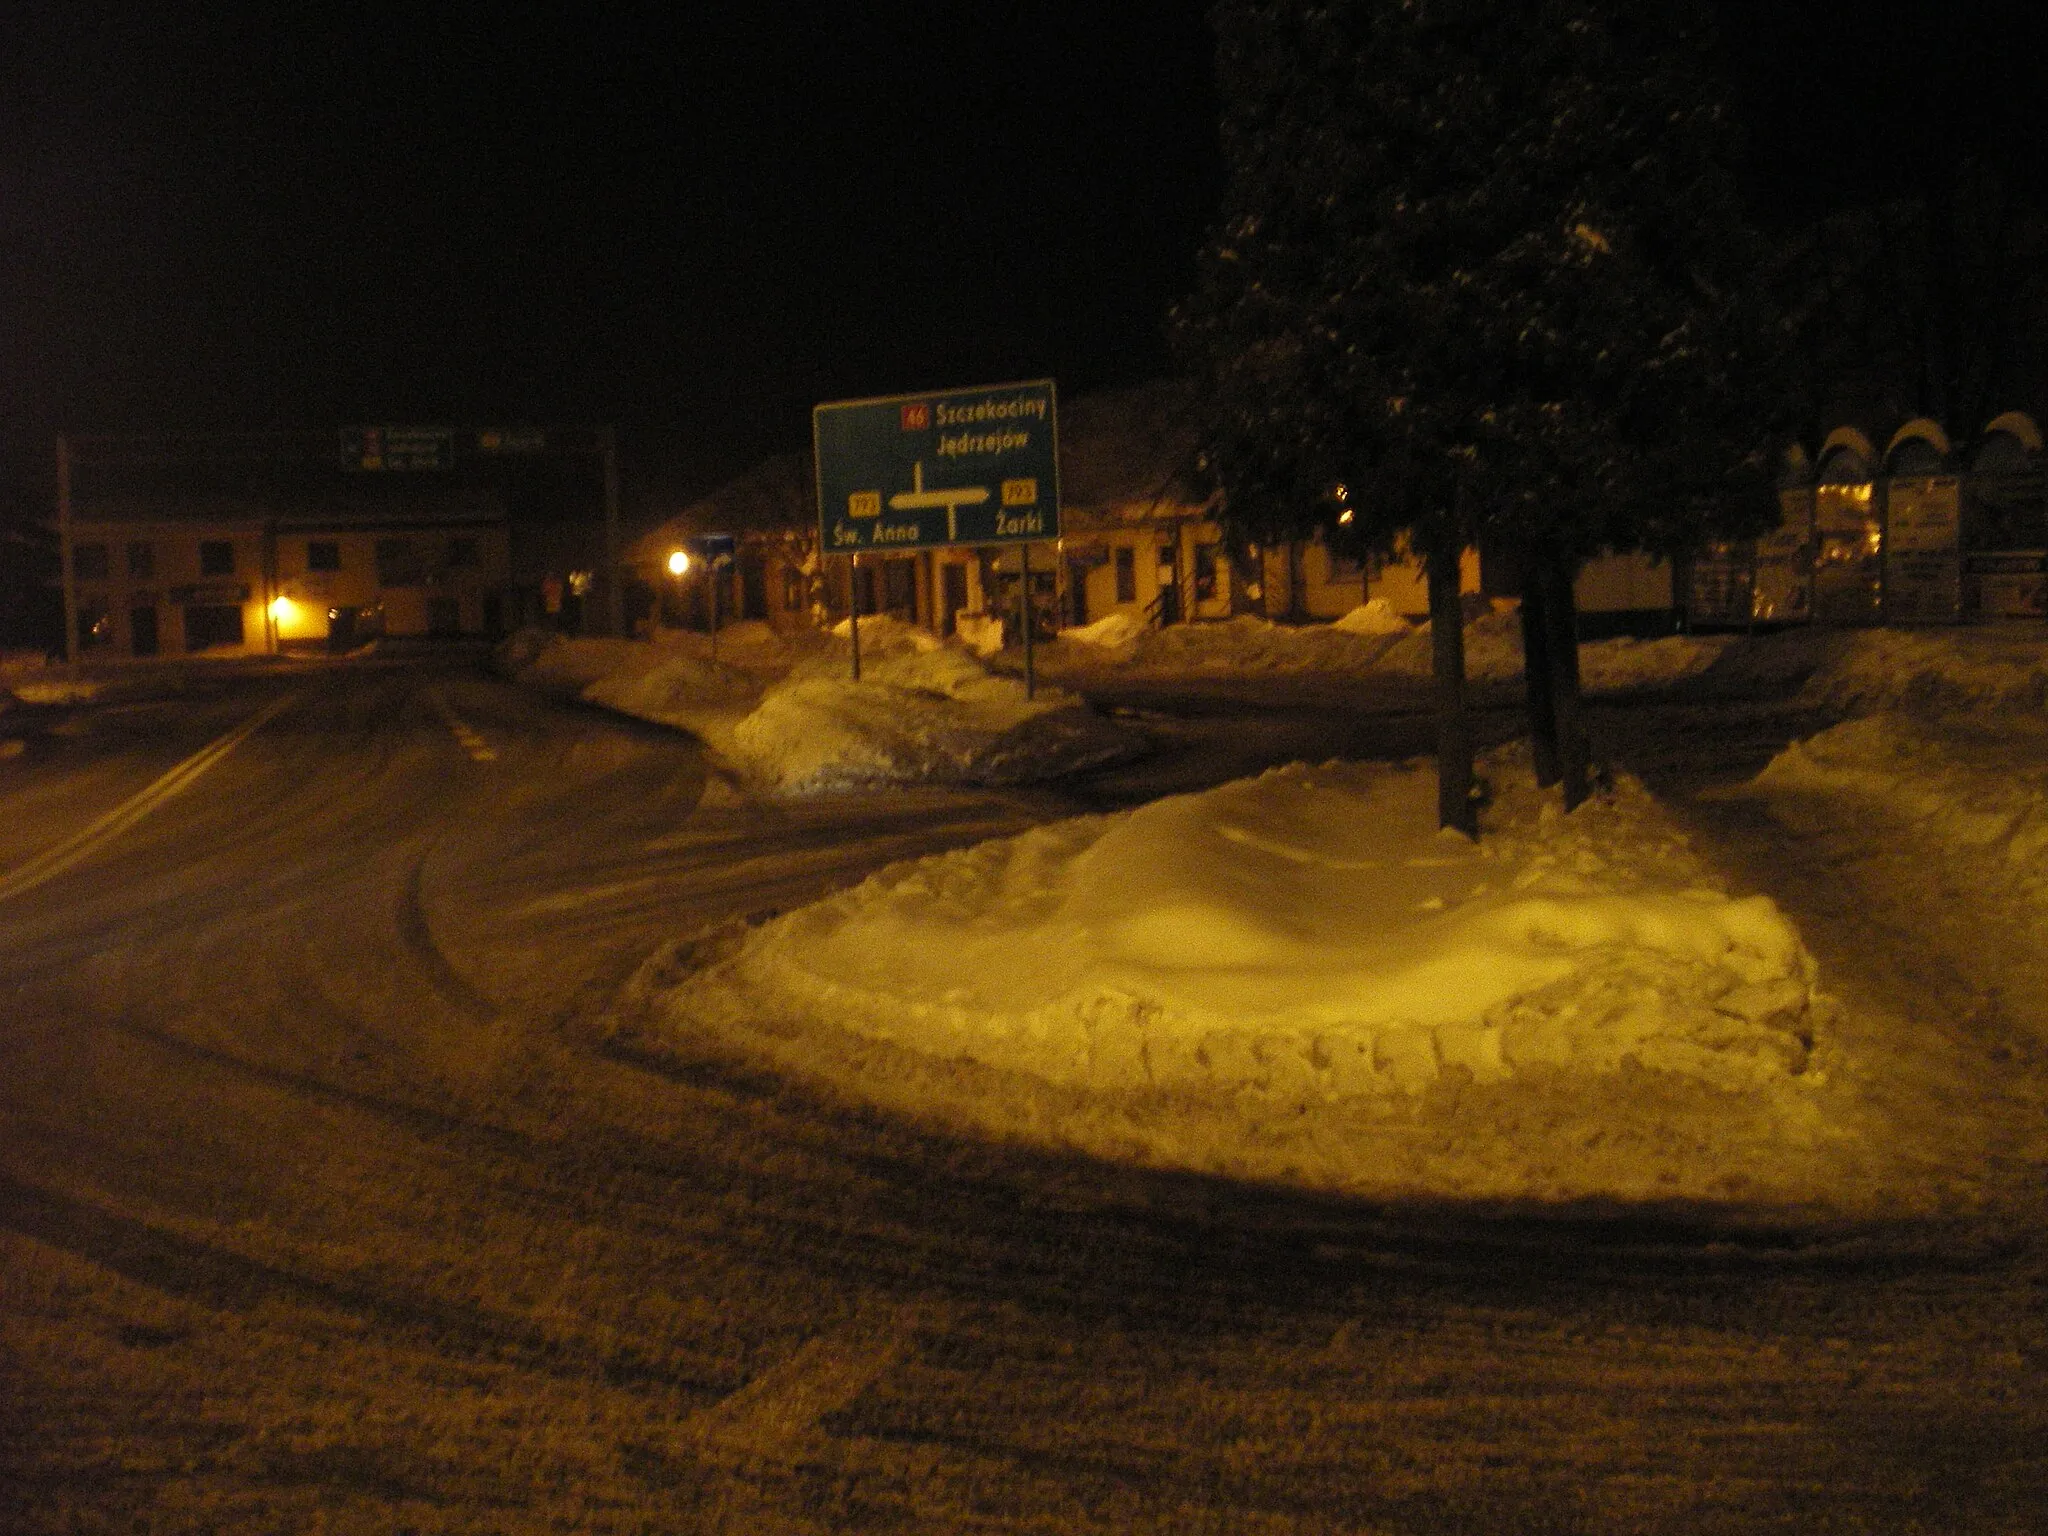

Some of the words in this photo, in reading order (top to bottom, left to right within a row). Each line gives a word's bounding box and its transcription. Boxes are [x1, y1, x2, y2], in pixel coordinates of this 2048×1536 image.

[907, 406, 924, 425] 46
[936, 398, 1047, 425] Szczekociny
[936, 429, 1029, 459] Jędrzejów
[872, 521, 919, 543] Anna
[995, 509, 1043, 535] Żarki
